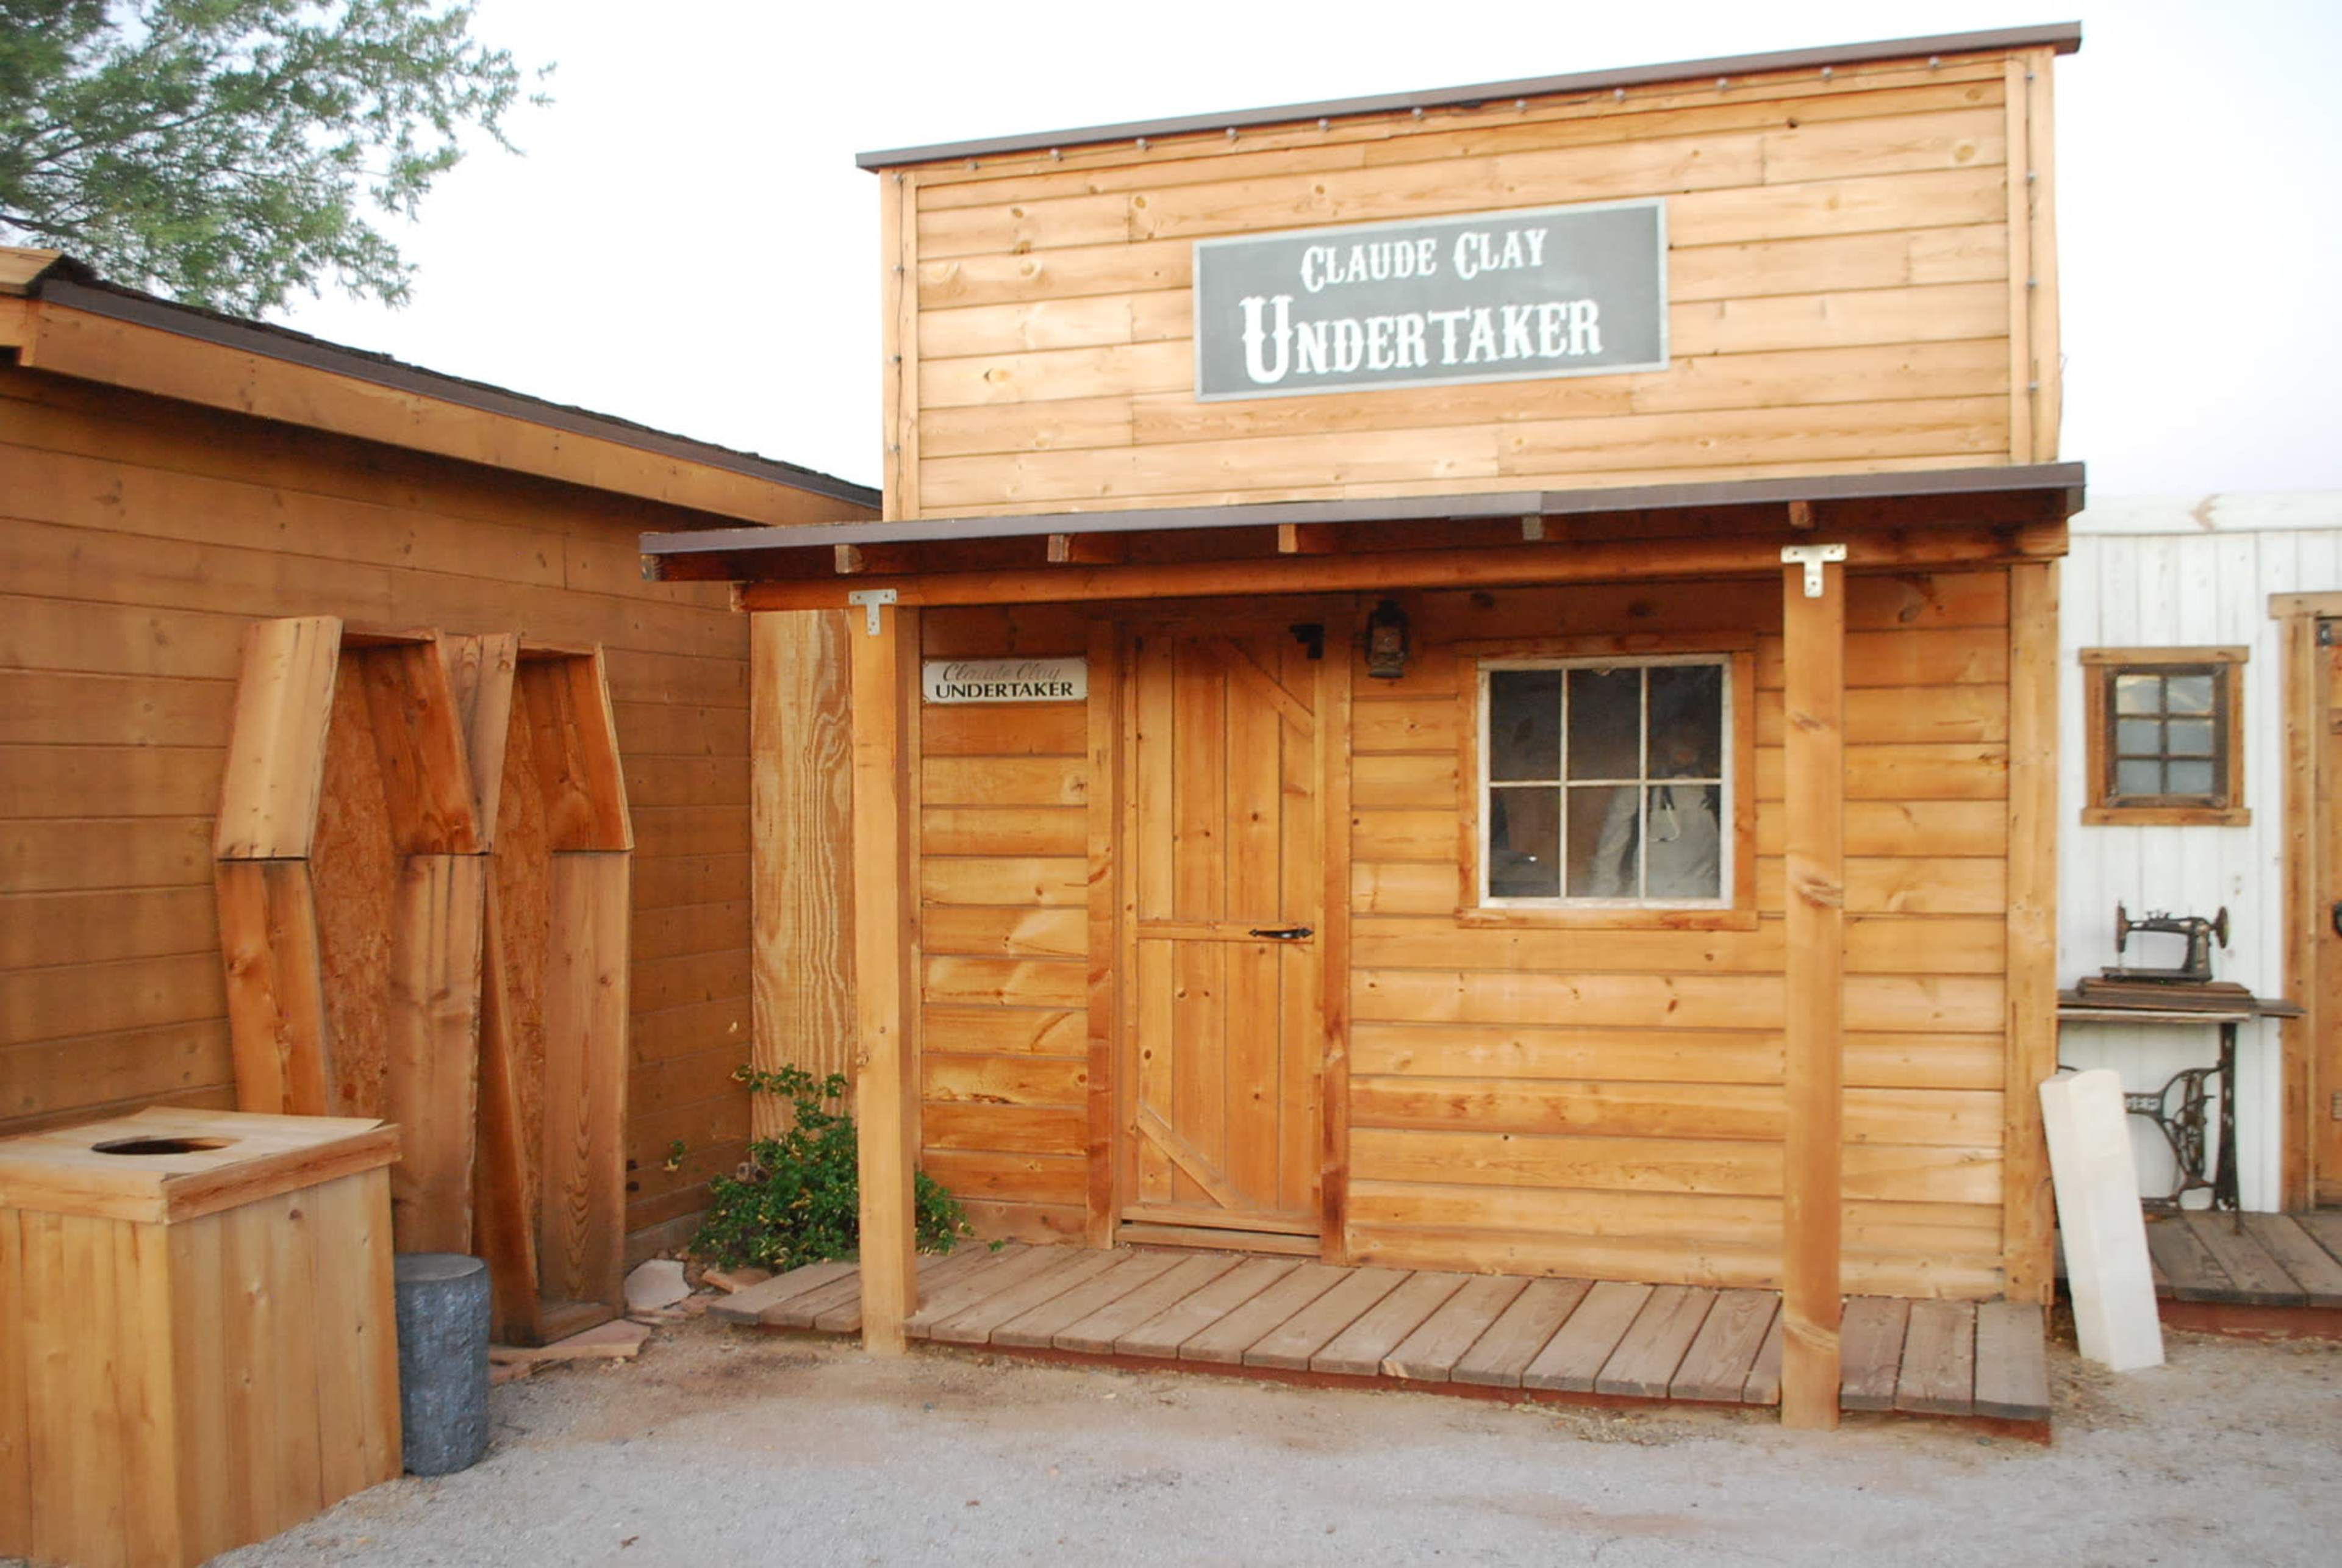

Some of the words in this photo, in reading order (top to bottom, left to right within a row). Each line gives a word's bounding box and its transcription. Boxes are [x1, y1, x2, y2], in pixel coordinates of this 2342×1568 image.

[1301, 238, 1437, 293] CLAUDE
[1453, 228, 1549, 280] CLAY
[1238, 294, 1604, 384] UNDERTAKER
[936, 682, 1073, 698] UNDERTAKER
[943, 662, 1011, 681] Claude
[1016, 662, 1062, 682] Clay
